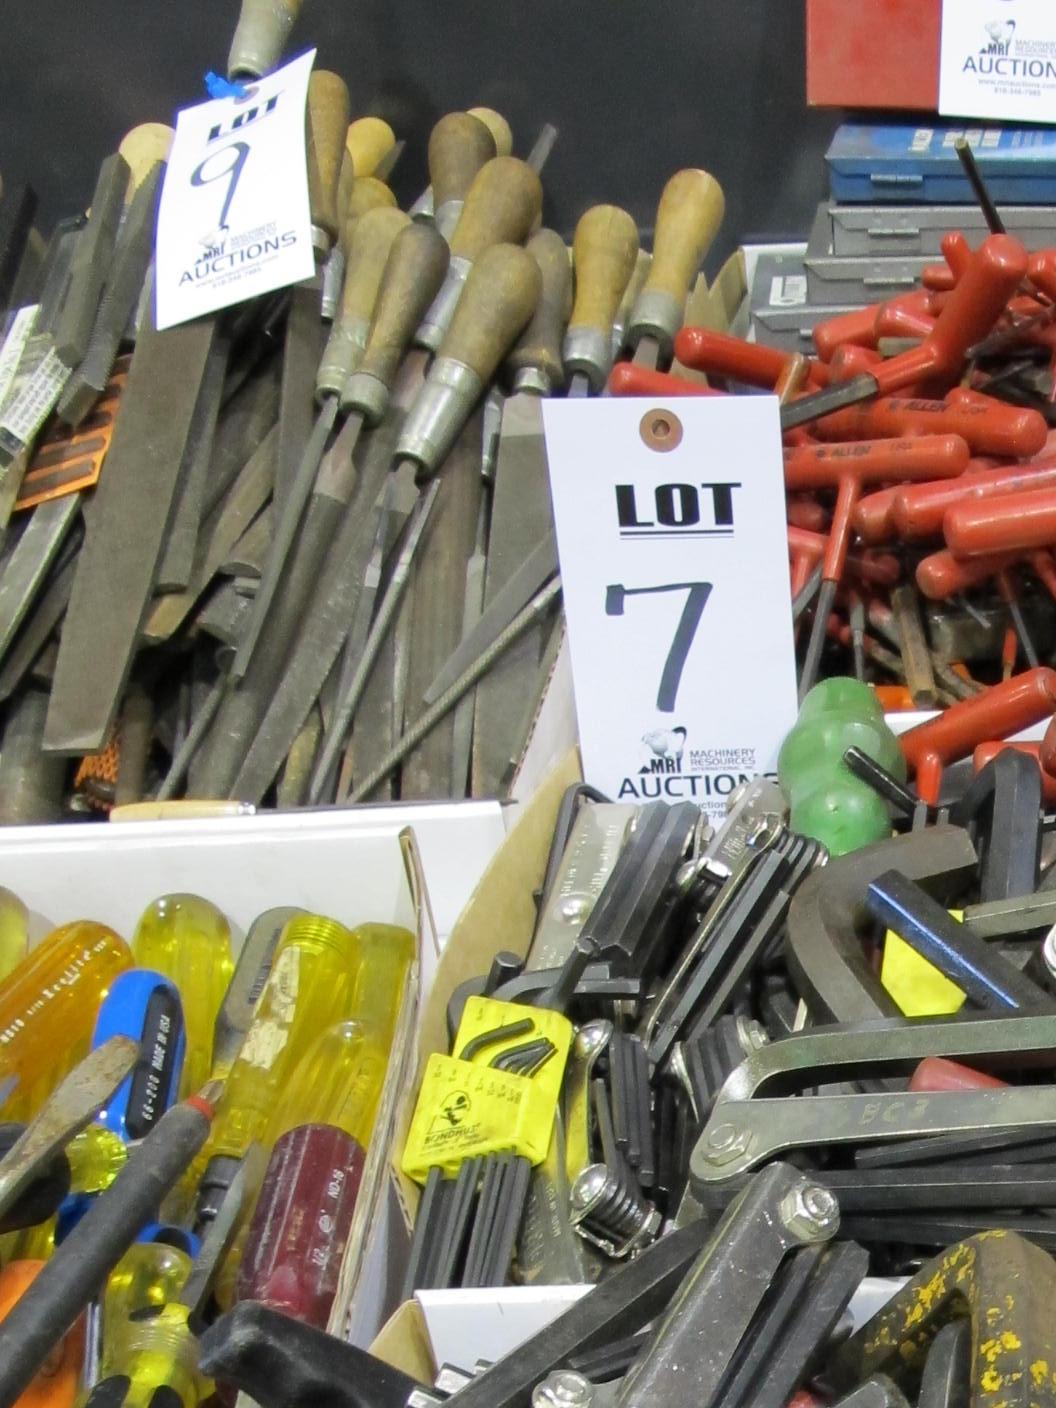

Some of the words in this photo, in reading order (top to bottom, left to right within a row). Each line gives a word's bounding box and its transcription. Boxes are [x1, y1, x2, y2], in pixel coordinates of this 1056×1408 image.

[208, 89, 285, 142] LOT
[190, 141, 250, 226] 9
[178, 230, 297, 287] AUCTIONS
[615, 482, 742, 528] LOT
[605, 582, 713, 713] 7
[650, 757, 682, 774] MRI
[690, 748, 756, 759] MACHINERY
[690, 757, 756, 767] RESOURCES
